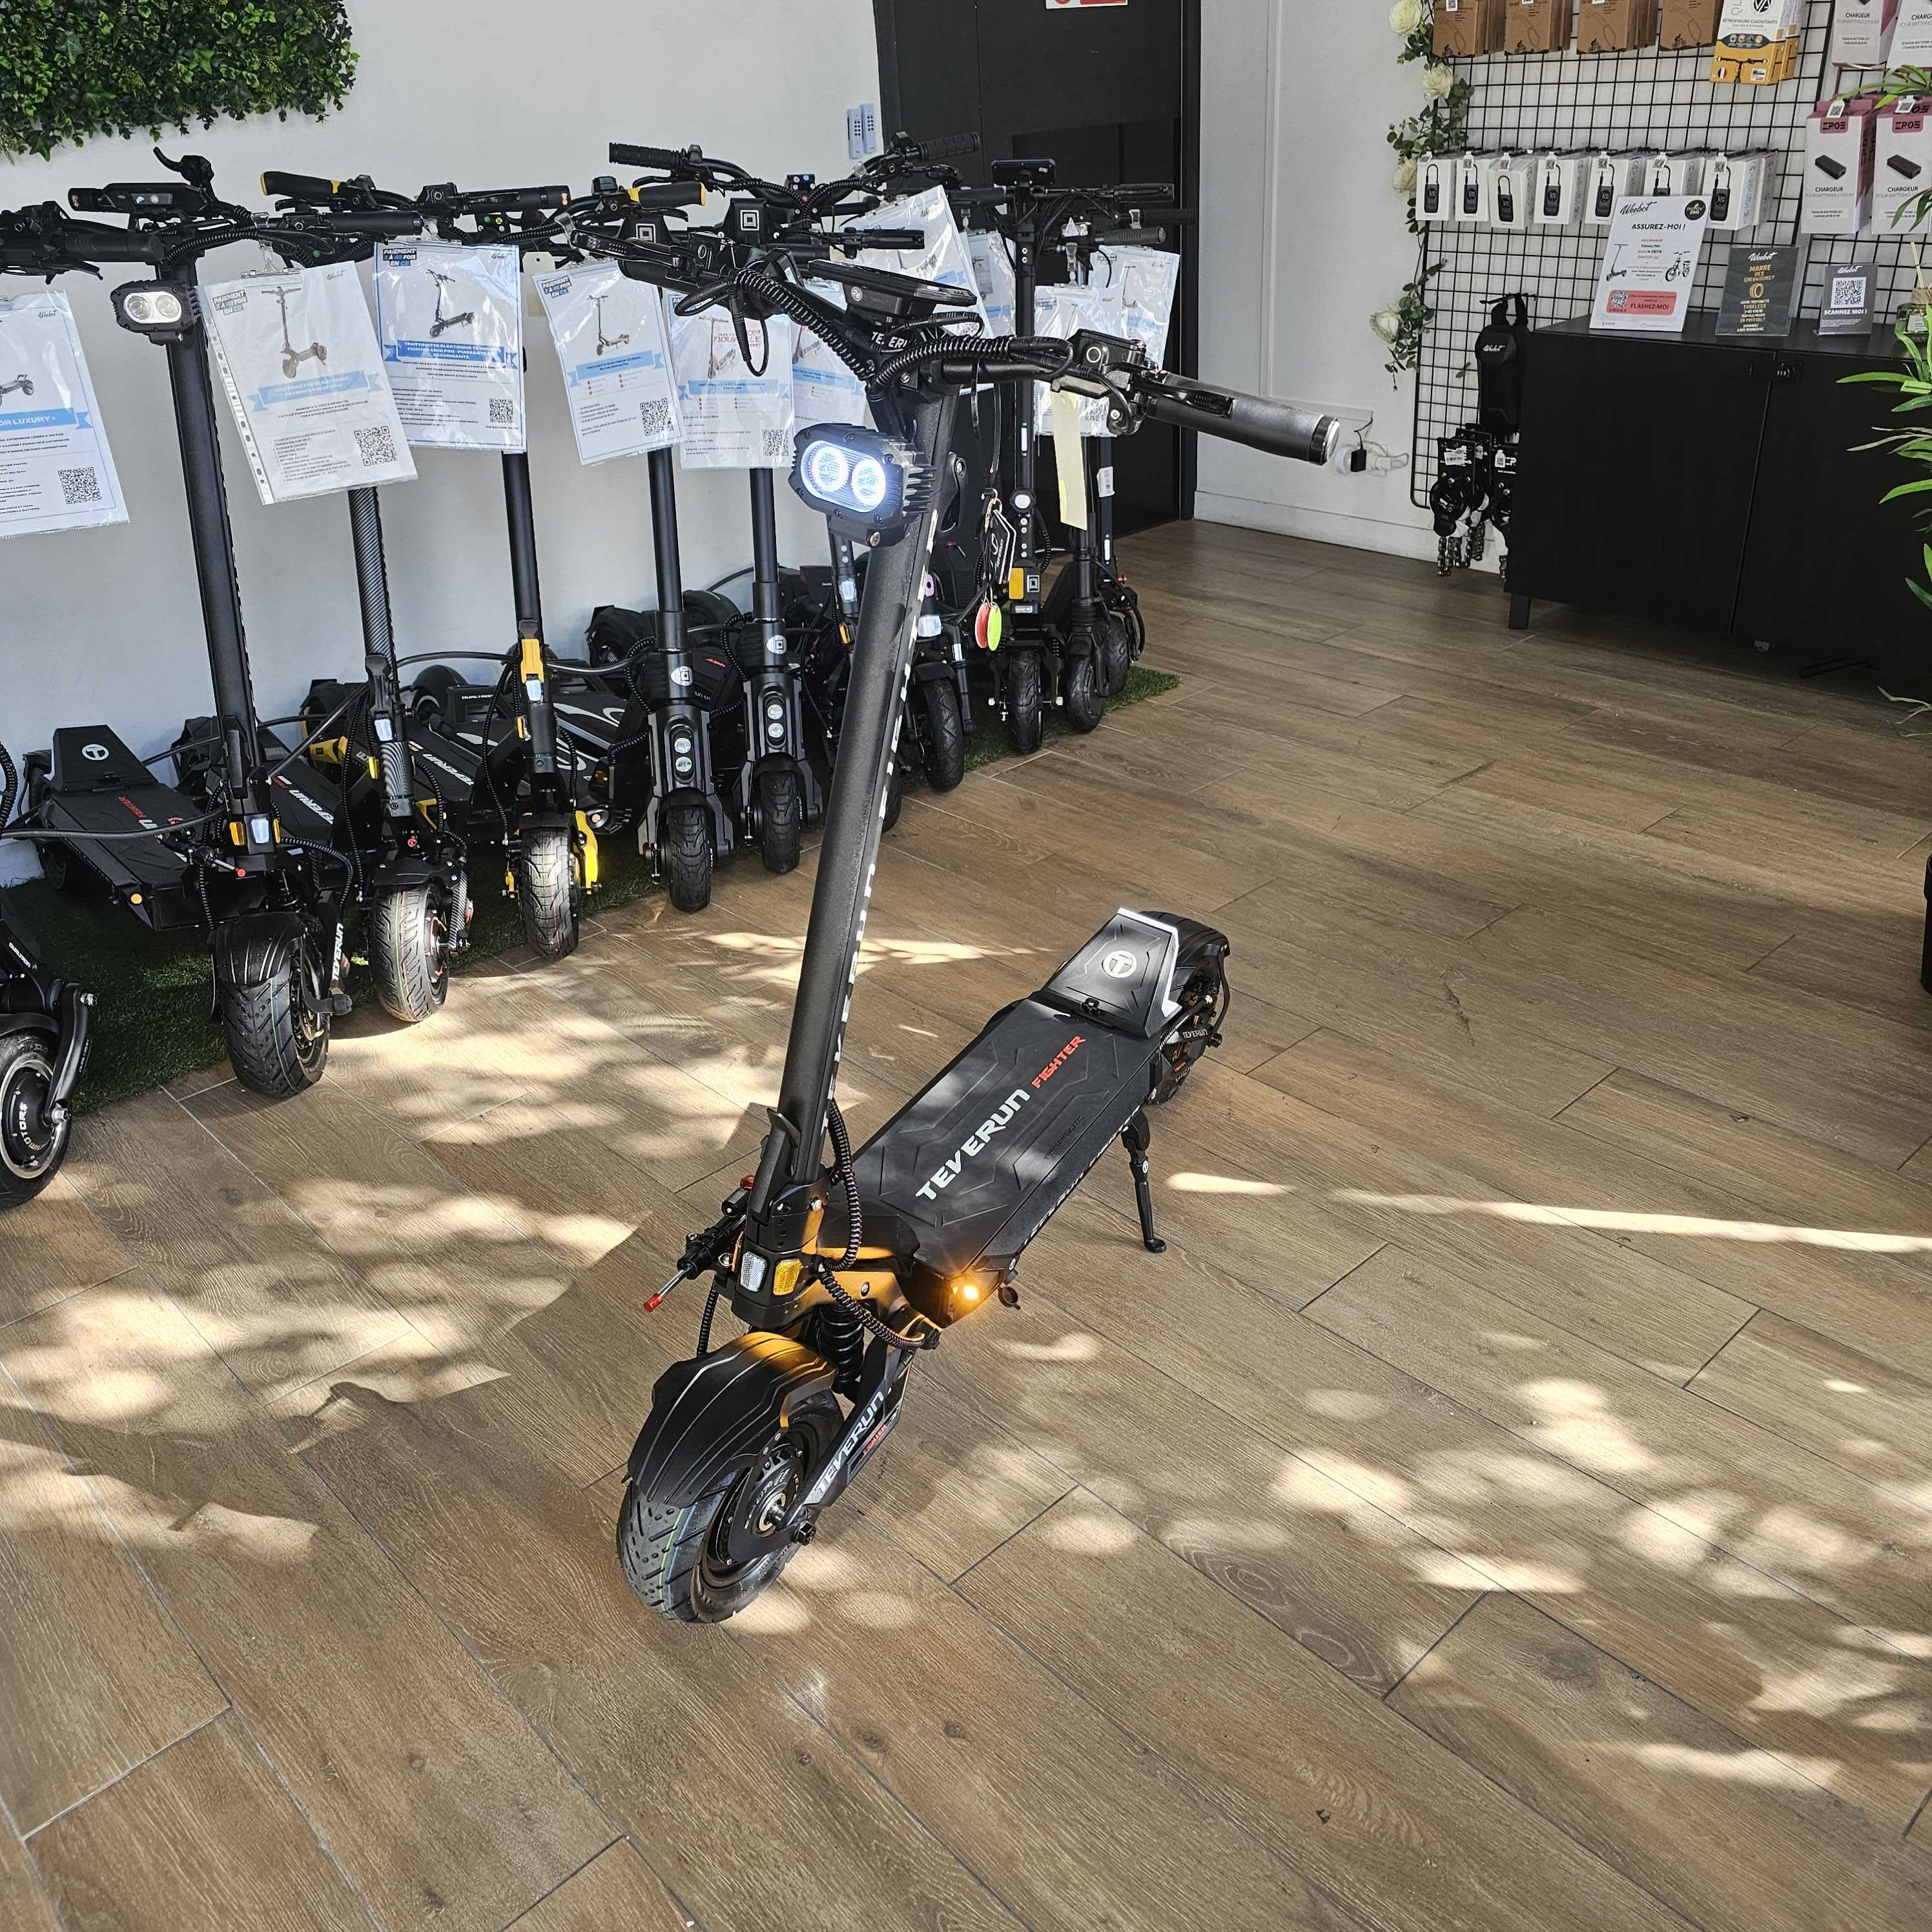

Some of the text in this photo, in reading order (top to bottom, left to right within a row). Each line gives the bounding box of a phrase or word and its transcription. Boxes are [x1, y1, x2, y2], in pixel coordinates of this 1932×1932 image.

[1620, 201, 1658, 215] Weebot
[1748, 252, 1778, 262] Weebot
[1837, 265, 1863, 274] Weebot
[542, 277, 569, 288] PAIEMENT
[213, 291, 245, 304] PAIEMENT
[37, 309, 57, 318] Weebot
[13, 416, 50, 425] LUXURY
[332, 923, 344, 981] TEVERUN
[1182, 1029, 1208, 1039] TEVERUN
[1032, 1036, 1086, 1089] FIGHTER
[914, 1088, 1031, 1202] TEVERUN
[814, 1391, 884, 1492] TEVERUN
